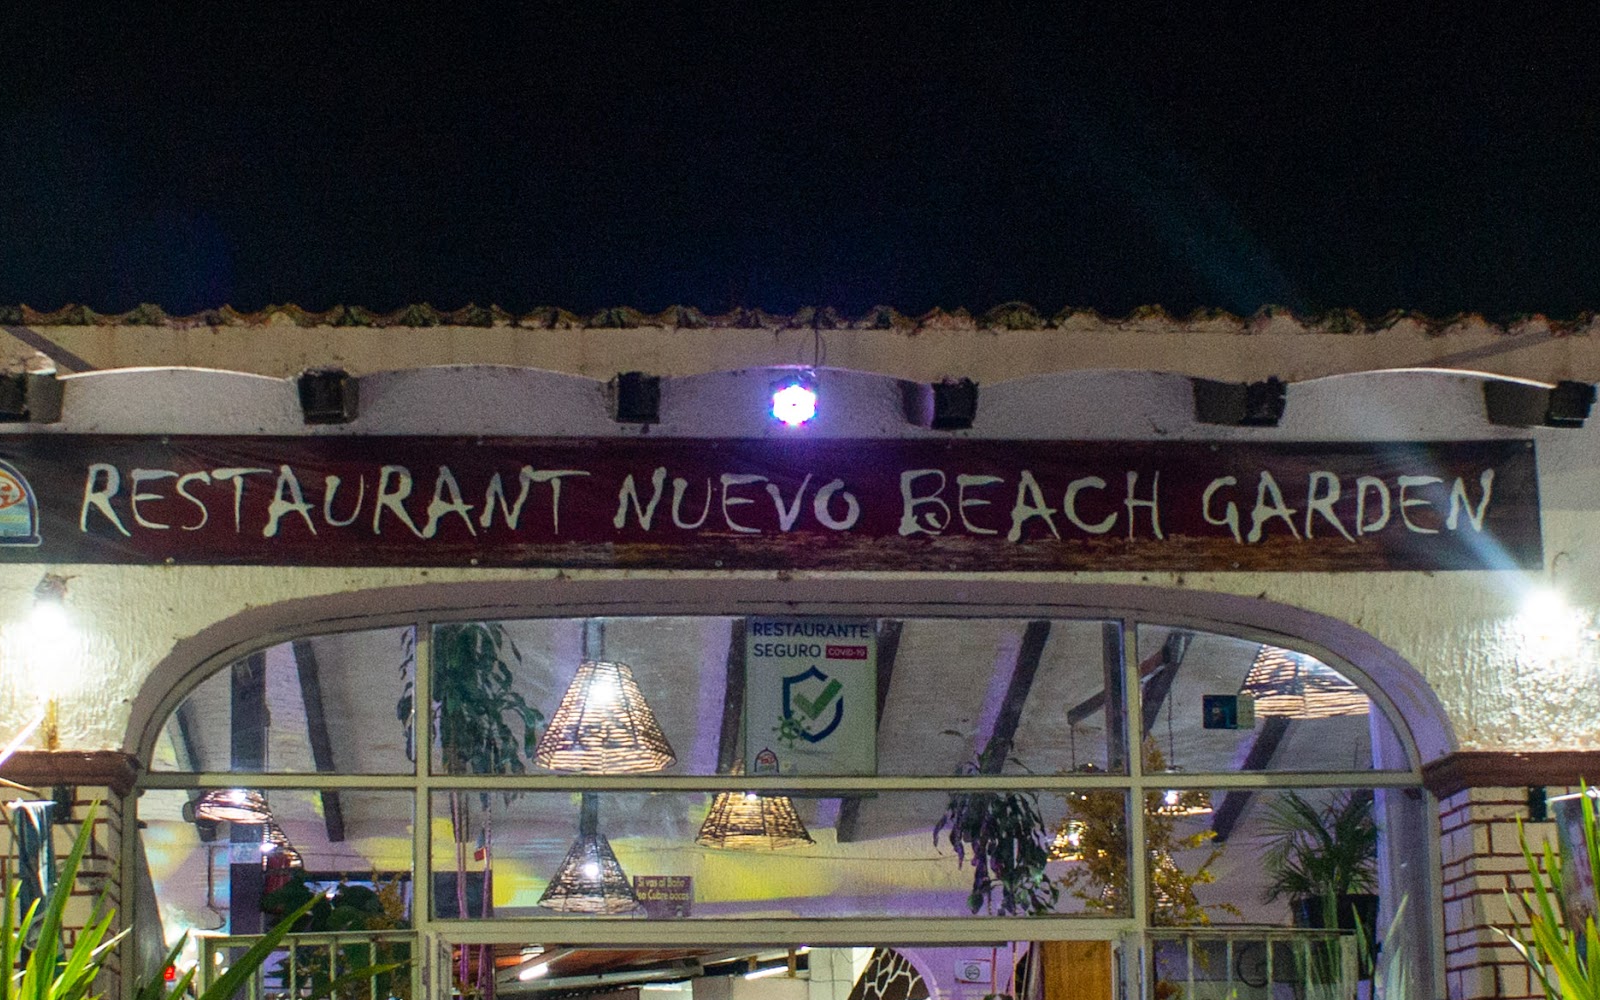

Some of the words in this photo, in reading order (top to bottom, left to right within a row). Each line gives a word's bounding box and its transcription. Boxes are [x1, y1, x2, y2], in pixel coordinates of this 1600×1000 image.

[79, 464, 590, 538] RESTAURANT
[613, 466, 860, 533] NUEVO
[898, 468, 1163, 541] BEACH
[1202, 468, 1495, 543] GARDEN
[753, 622, 869, 638] RESTAURANTE
[753, 643, 822, 658] SEGURO
[827, 646, 866, 657] COVID-19
